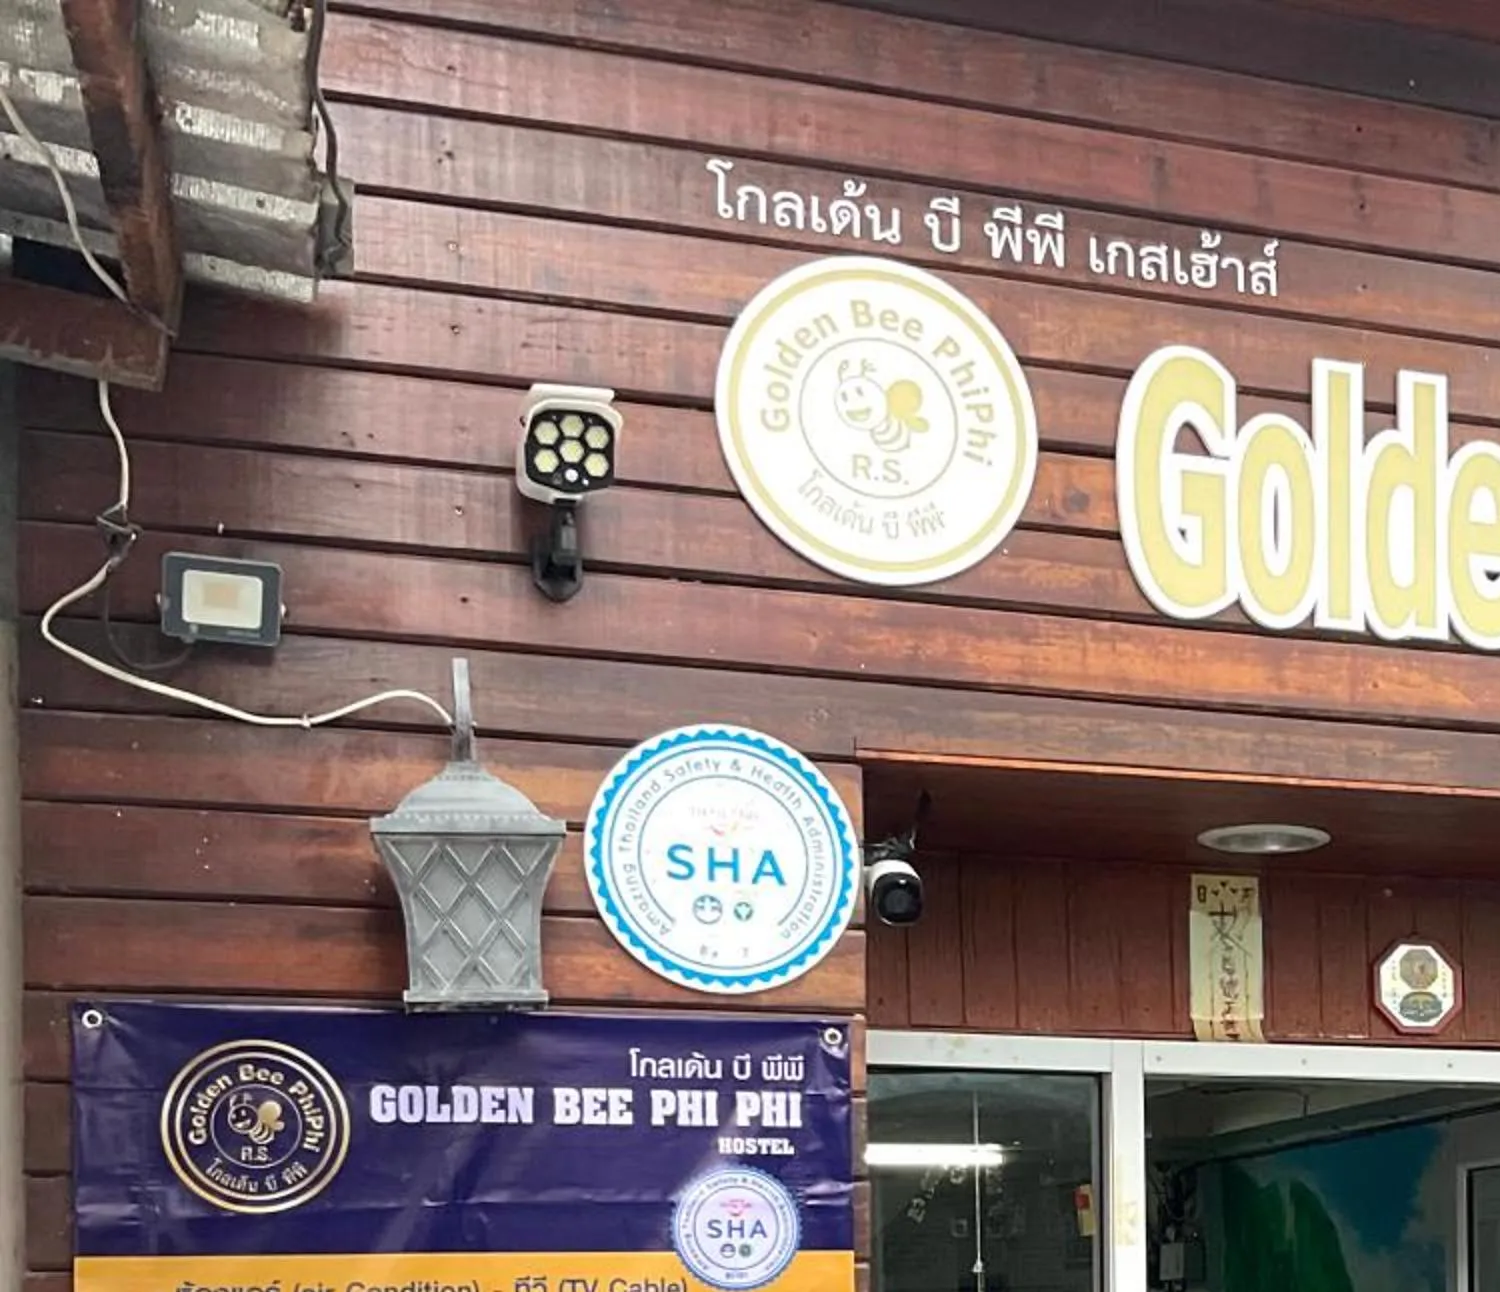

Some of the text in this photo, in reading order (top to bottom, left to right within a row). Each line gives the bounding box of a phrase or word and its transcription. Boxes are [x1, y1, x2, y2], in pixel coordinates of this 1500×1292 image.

[706, 158, 1279, 296] โกลเด้น บี พีพี เกสเฮ้าส์
[761, 299, 999, 467] Golden Bee PhiPhi
[852, 455, 910, 485] R.S.
[798, 473, 874, 536] โกลเด้น
[881, 503, 899, 540] บี
[618, 778, 665, 853] Thailand
[664, 757, 721, 782] Safety
[731, 758, 742, 772] &
[751, 765, 803, 812] Health
[781, 815, 827, 939] Administration
[666, 843, 786, 886] SHA
[629, 1048, 804, 1080] โกลเด้น บี พีพี
[188, 1064, 325, 1152] Golden Bee PhiPhi
[370, 1085, 802, 1128] GOLDEN BEE PHI PHI
[718, 1137, 795, 1155] HOSTEL
[707, 1220, 768, 1239] SHA
